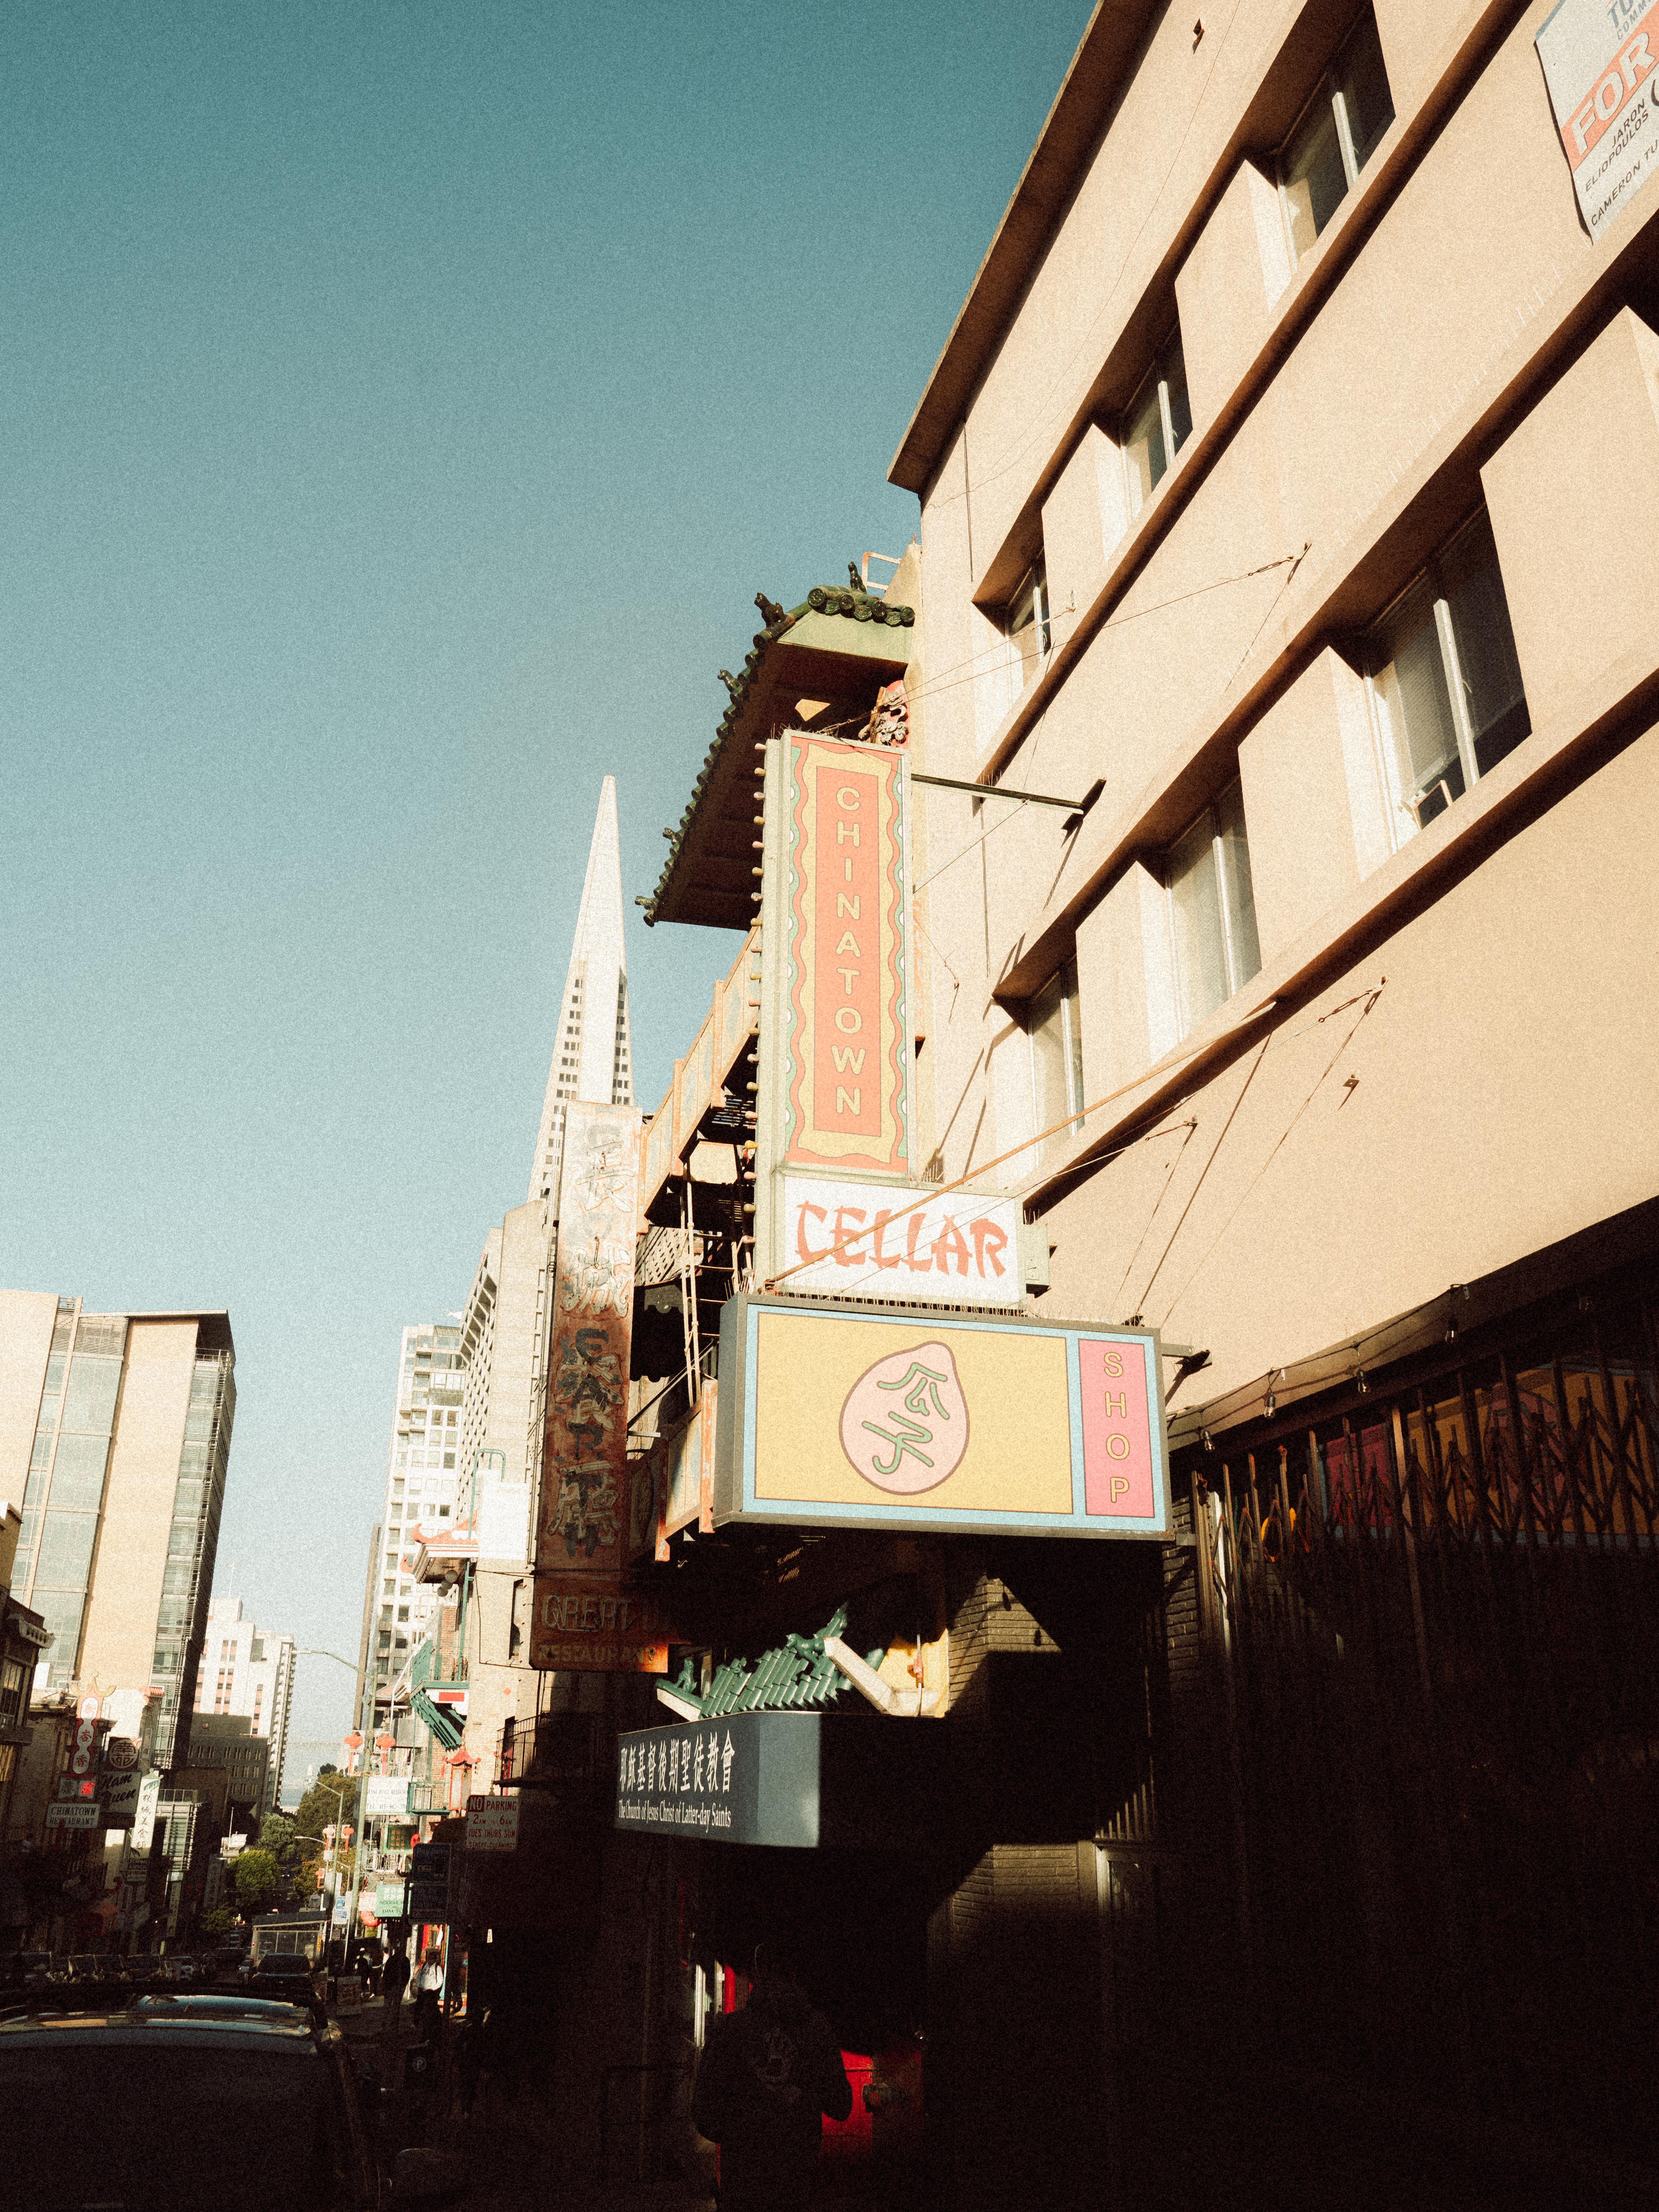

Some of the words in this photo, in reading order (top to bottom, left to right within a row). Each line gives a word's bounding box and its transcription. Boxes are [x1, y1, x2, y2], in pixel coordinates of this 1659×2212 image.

[1617, 0, 1652, 40] COMM
[1571, 32, 1656, 157] FOR
[1612, 98, 1645, 148] JARON
[1586, 109, 1649, 192] ELIOPOULOS
[1591, 160, 1640, 227] CAMERON
[1644, 139, 1659, 161] TU
[831, 786, 866, 1117] CHINATOWN
[794, 1200, 1008, 1278] CELLAR
[1103, 1352, 1131, 1504] SHOP
[620, 1729, 735, 1794] 耶穌基督後期聖徒教會
[51, 1806, 97, 1816] CHINATOWN
[470, 1797, 483, 1810] NO
[486, 1801, 517, 1811] PARKING
[473, 1814, 486, 1824] 2AM
[499, 1815, 512, 1825] 6AM
[625, 1799, 641, 1819] Church
[641, 1800, 647, 1820] of
[647, 1800, 659, 1824] Jesus
[659, 1799, 675, 1822] Christ
[675, 1801, 681, 1824] of
[682, 1801, 711, 1833] Latter-day
[712, 1803, 731, 1827] Saints
[468, 1829, 482, 1837] TUES
[485, 1829, 502, 1838] THURS
[504, 1829, 515, 1838] SUN
